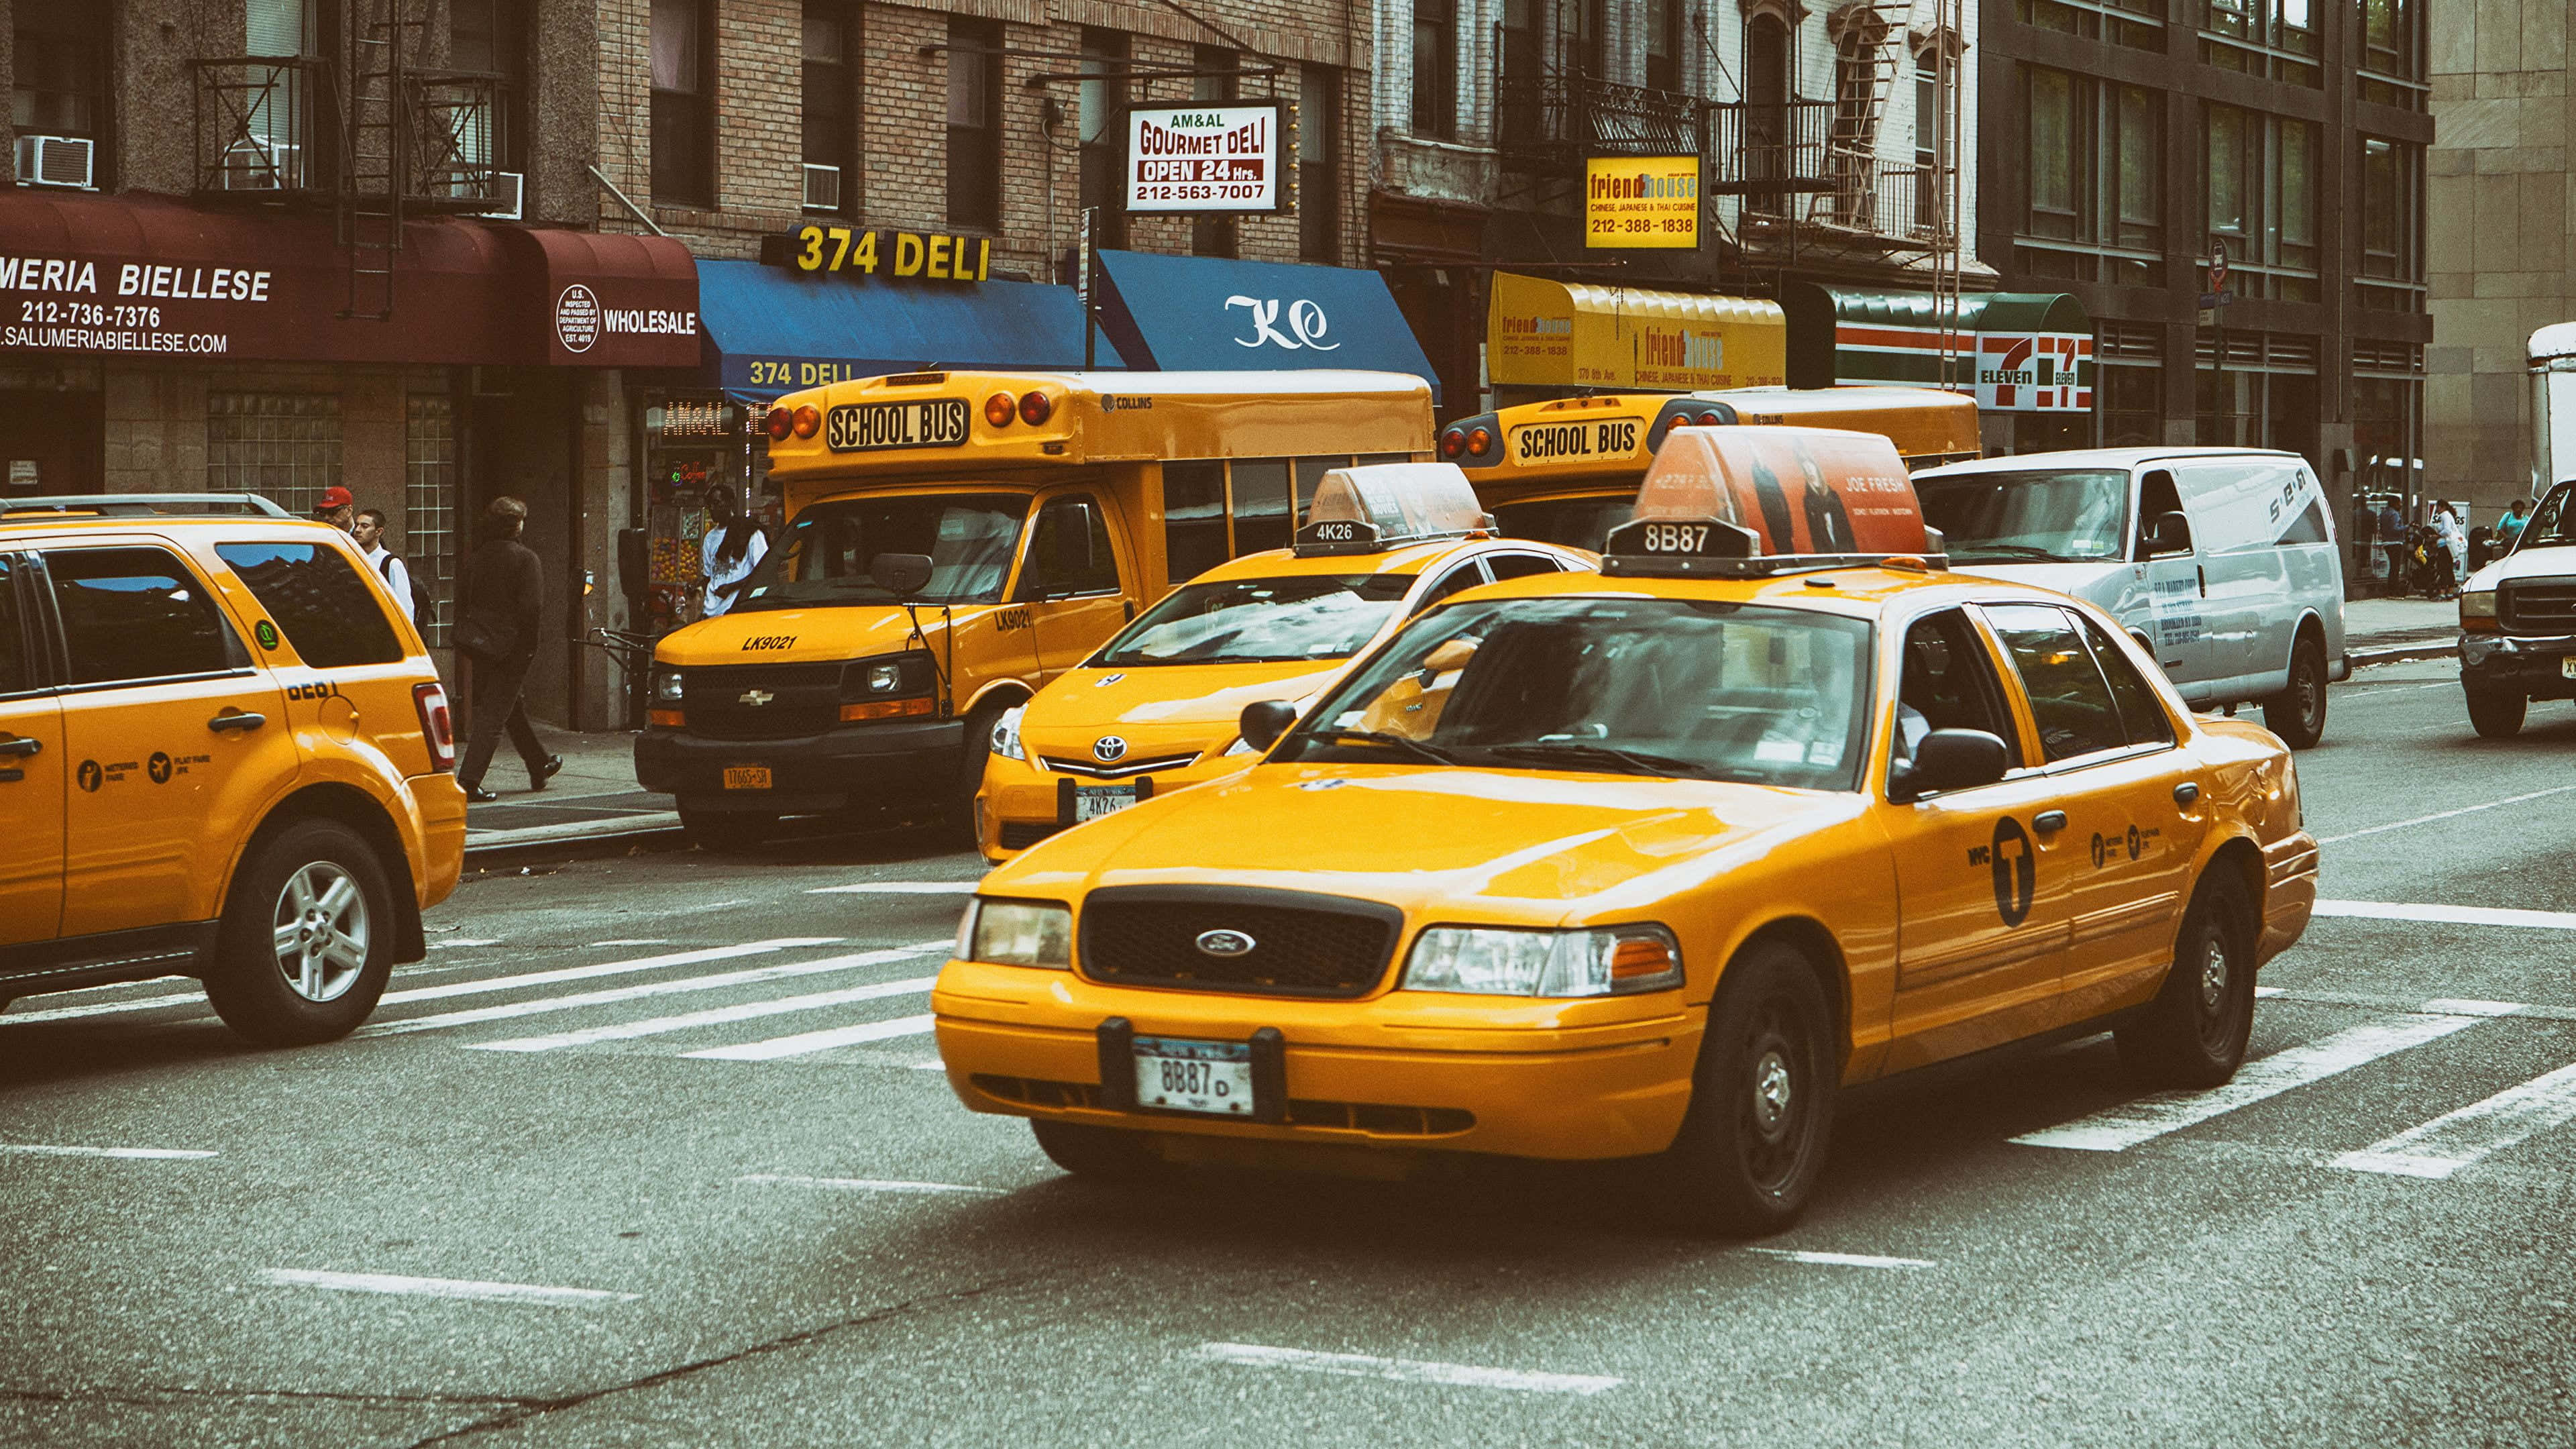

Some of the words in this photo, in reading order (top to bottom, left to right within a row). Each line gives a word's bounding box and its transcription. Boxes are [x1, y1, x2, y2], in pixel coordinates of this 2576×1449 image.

[1171, 114, 1224, 127] AM&AL
[1140, 120, 1222, 155] GOURMET
[1228, 116, 1265, 154] DELI
[1144, 161, 1194, 181] OPEN
[1201, 160, 1230, 180] 24
[1233, 167, 1257, 180] Hrs.
[1136, 184, 1264, 199] 212-563-7007
[1619, 203, 1648, 211] JAPANESE
[1657, 203, 1670, 211] THAI
[1672, 203, 1696, 211] CUISINE
[798, 226, 878, 274] 374
[895, 232, 990, 281] DELI
[118, 264, 270, 301] BIELLESE
[572, 290, 584, 299] U.S.
[21, 301, 160, 327] 212-736-7376
[604, 309, 696, 335] WHOLESALE
[0, 326, 227, 353] .SALUMERIABIELLESE.COM
[750, 361, 792, 384] 374
[801, 363, 851, 386] DELI
[1697, 374, 1709, 384] THAI
[1711, 374, 1732, 386] CUISINE
[1117, 396, 1152, 409] COLLINS
[830, 405, 913, 446] SCHOOL
[920, 402, 962, 441] BUS
[1521, 426, 1591, 458] SCHOOL
[1599, 423, 1635, 453] BUS
[1846, 477, 1868, 492] JOE
[1868, 477, 1906, 492] FRESH
[1317, 524, 1352, 539] 4K26
[1646, 525, 1709, 552] 8B87
[994, 608, 1031, 631] LK9021
[741, 636, 798, 651] LK9021
[1967, 845, 1990, 867] NYC
[1161, 1060, 1211, 1095] 8B87
